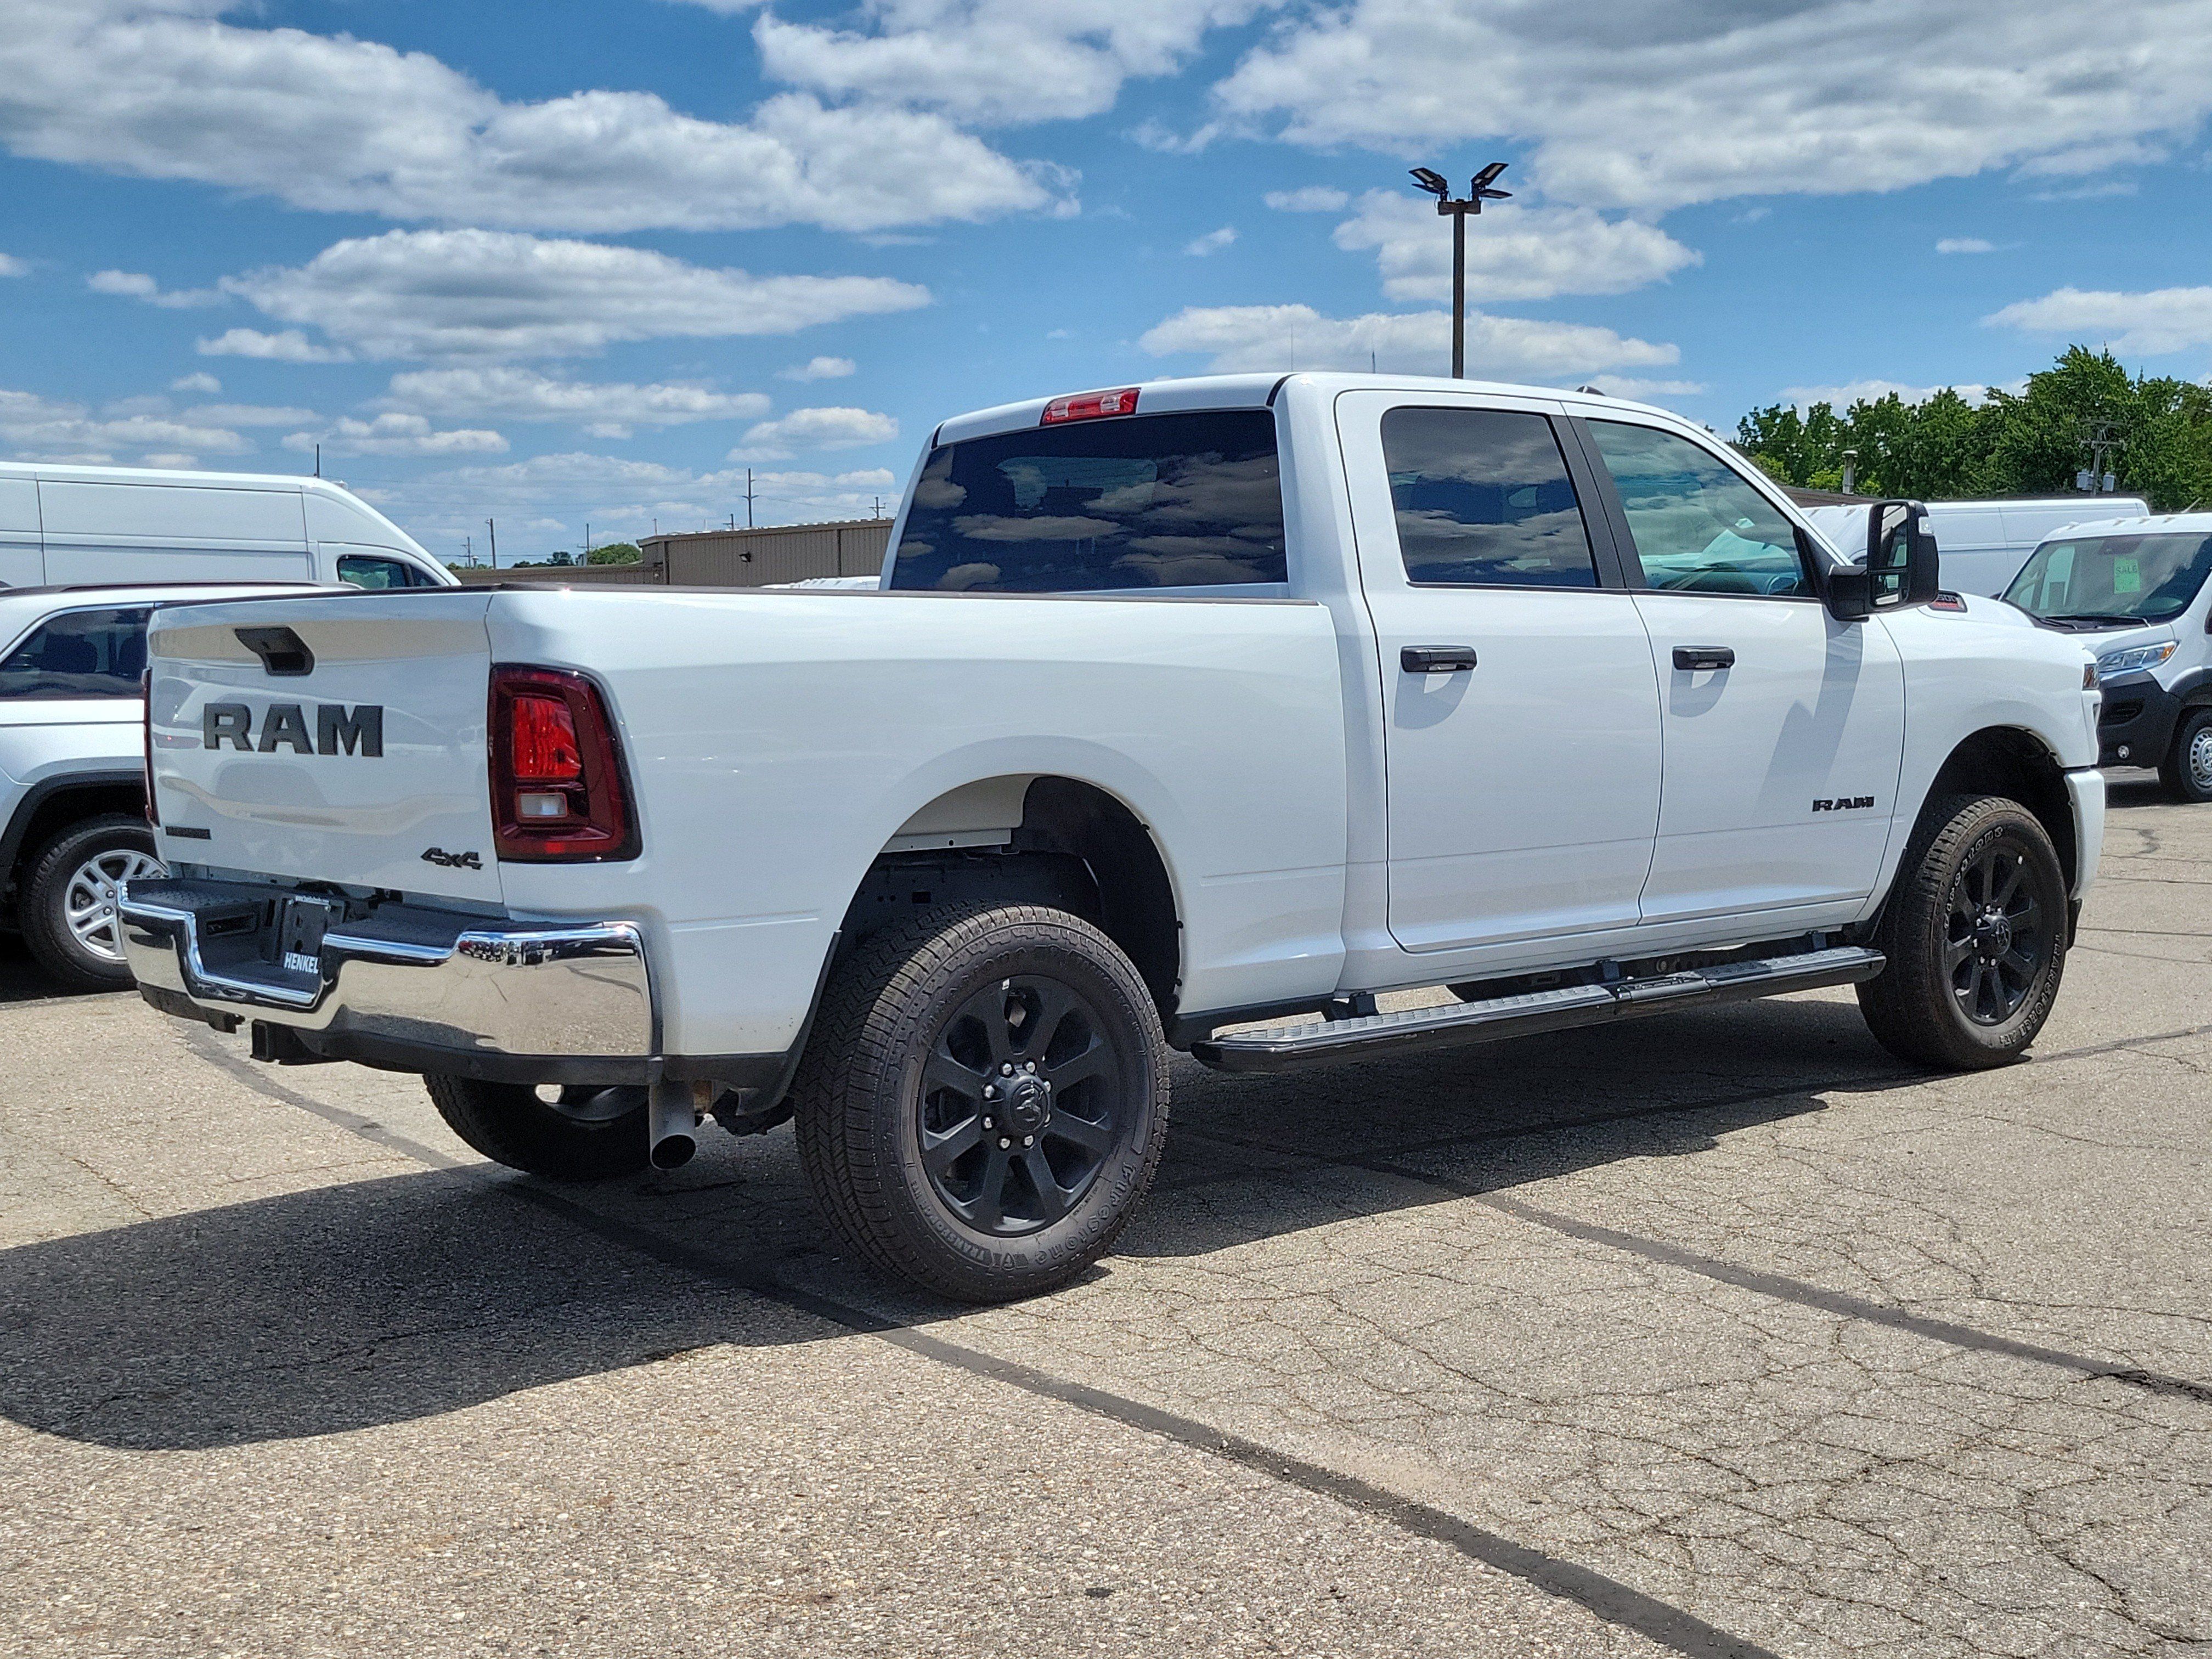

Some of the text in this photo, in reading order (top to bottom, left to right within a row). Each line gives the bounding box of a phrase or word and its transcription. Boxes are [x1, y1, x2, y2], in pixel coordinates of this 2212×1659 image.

[204, 703, 383, 758] RAM
[1812, 795, 1874, 812] RAM
[420, 847, 484, 870] 4x4
[284, 952, 319, 974] HENKEL
[1035, 1162, 1137, 1265] Firestone
